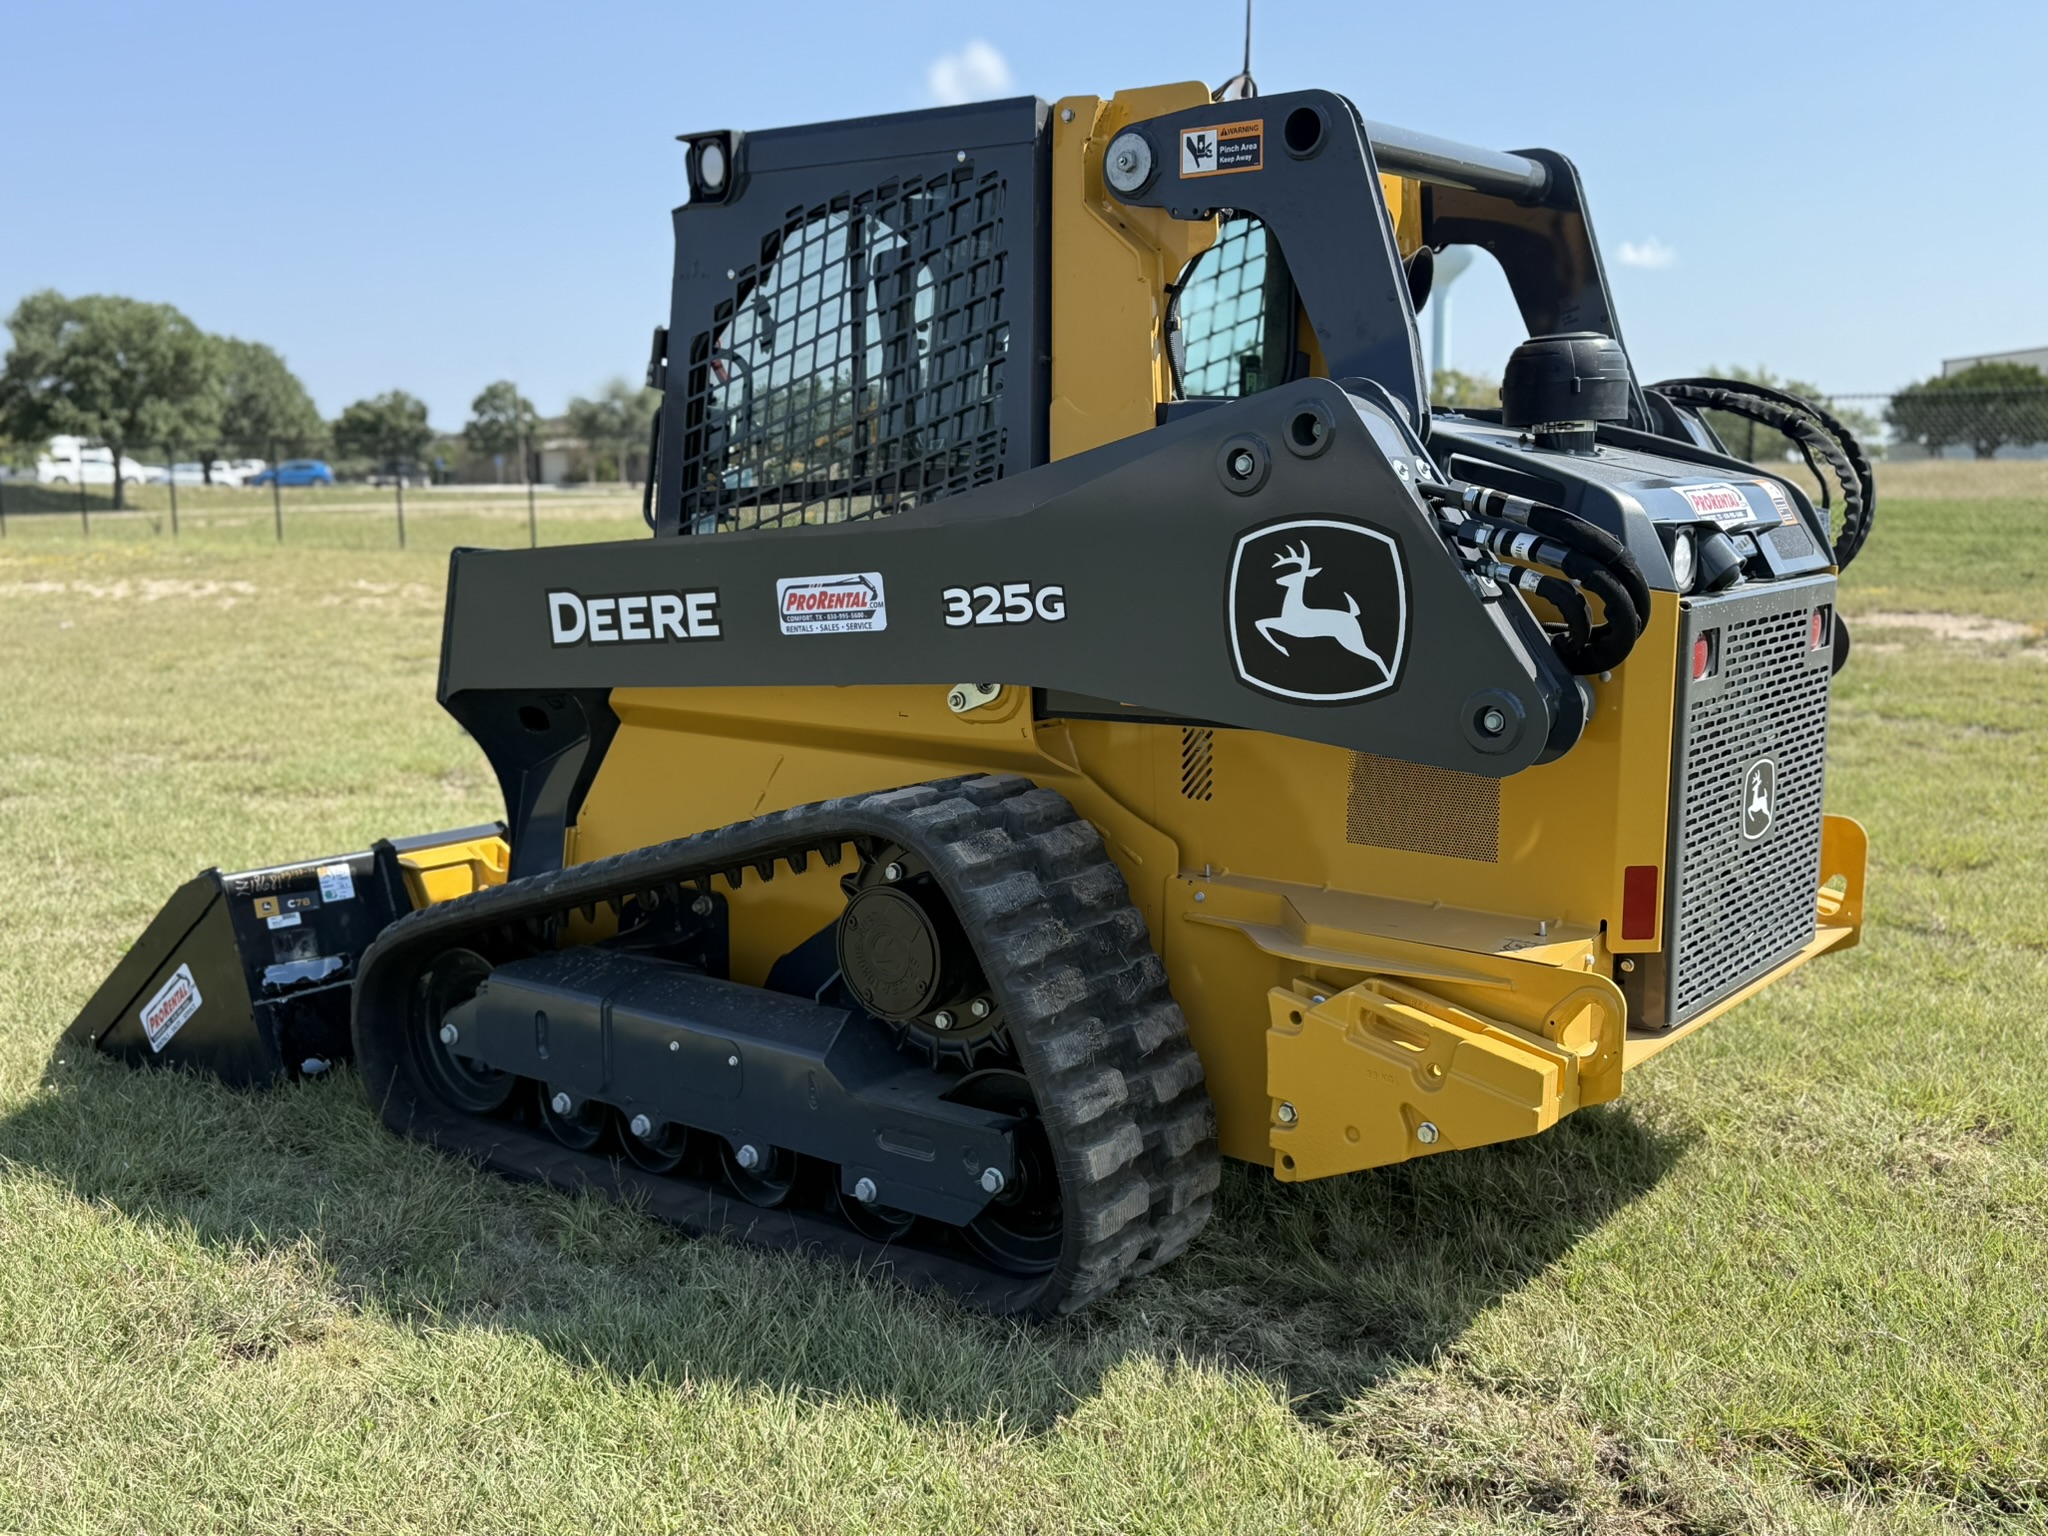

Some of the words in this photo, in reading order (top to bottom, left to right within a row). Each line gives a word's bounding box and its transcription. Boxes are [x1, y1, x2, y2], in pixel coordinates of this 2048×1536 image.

[1227, 124, 1259, 135] WARNING
[1219, 144, 1240, 154] Pinch
[1240, 143, 1258, 152] Area
[1219, 156, 1235, 164] Keep
[1235, 154, 1252, 162] Away
[943, 583, 1066, 626] 325G
[548, 592, 720, 644] DEERE
[786, 624, 814, 633] RENTALS
[820, 623, 840, 632] SALES
[845, 622, 873, 631] SERVICE
[286, 897, 311, 909] C78
